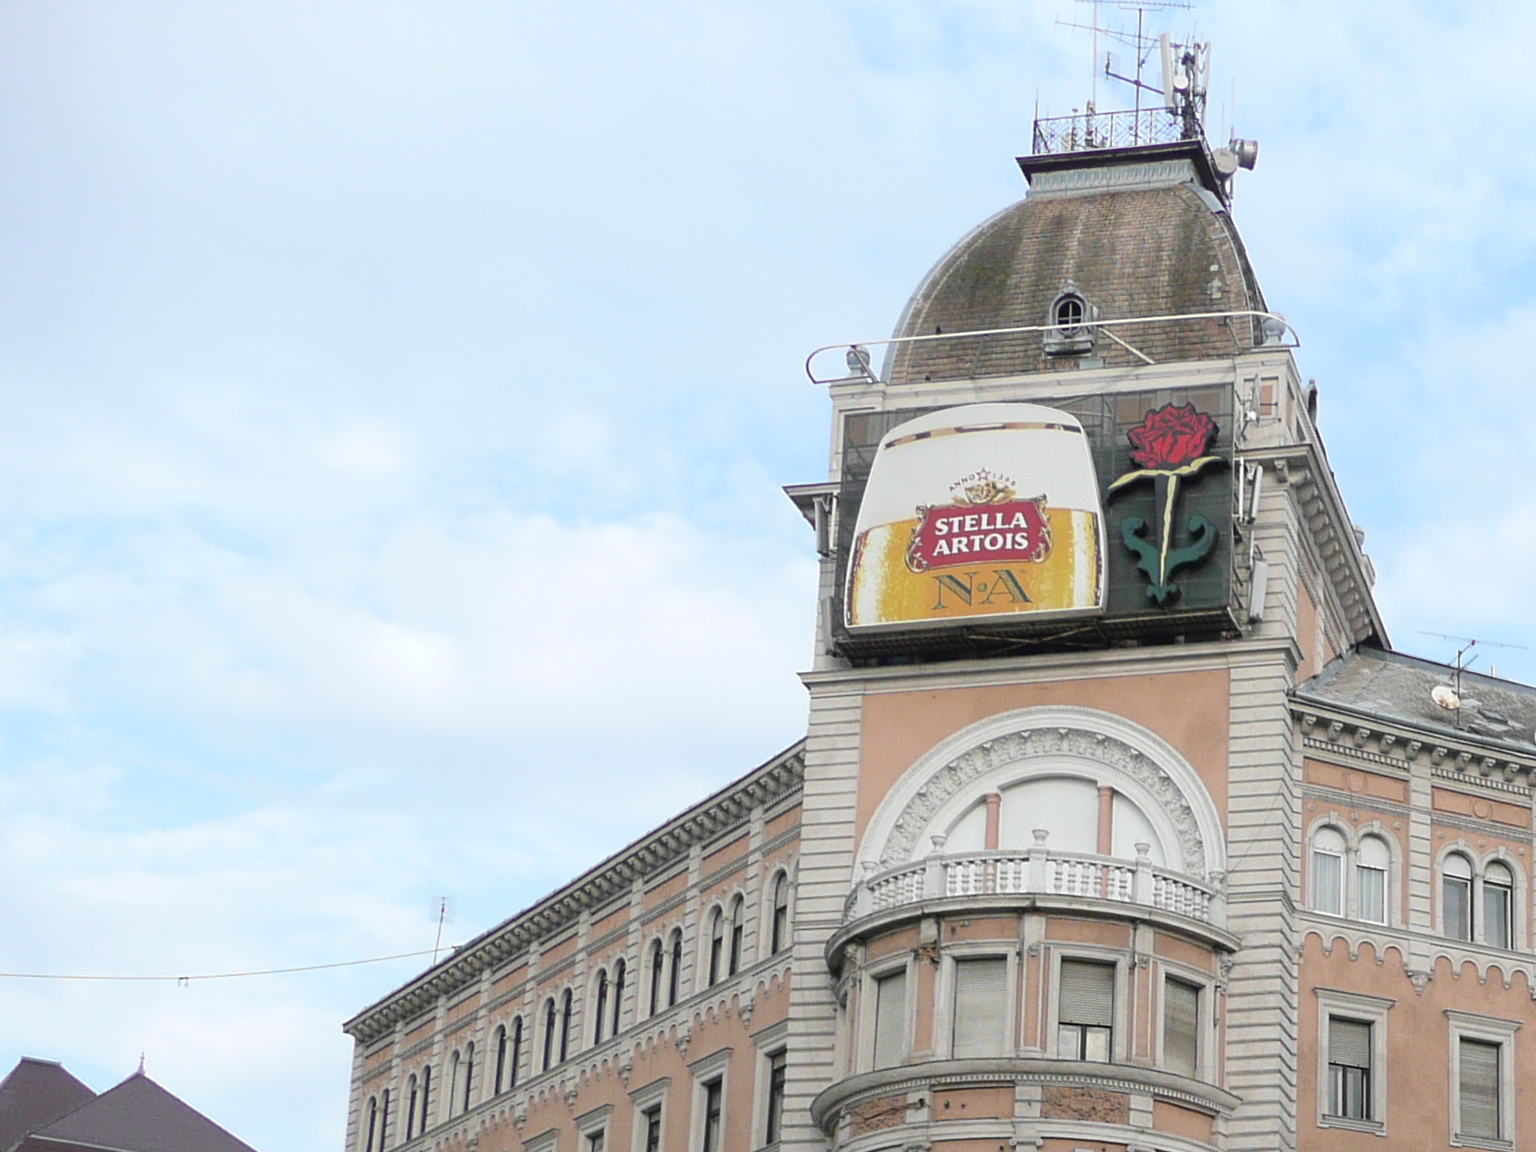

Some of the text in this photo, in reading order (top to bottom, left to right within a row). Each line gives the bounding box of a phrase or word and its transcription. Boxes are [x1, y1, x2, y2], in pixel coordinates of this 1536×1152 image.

[948, 473, 976, 492] ANNO
[934, 512, 1028, 536] STELLA
[932, 532, 1029, 557] ARTOIS
